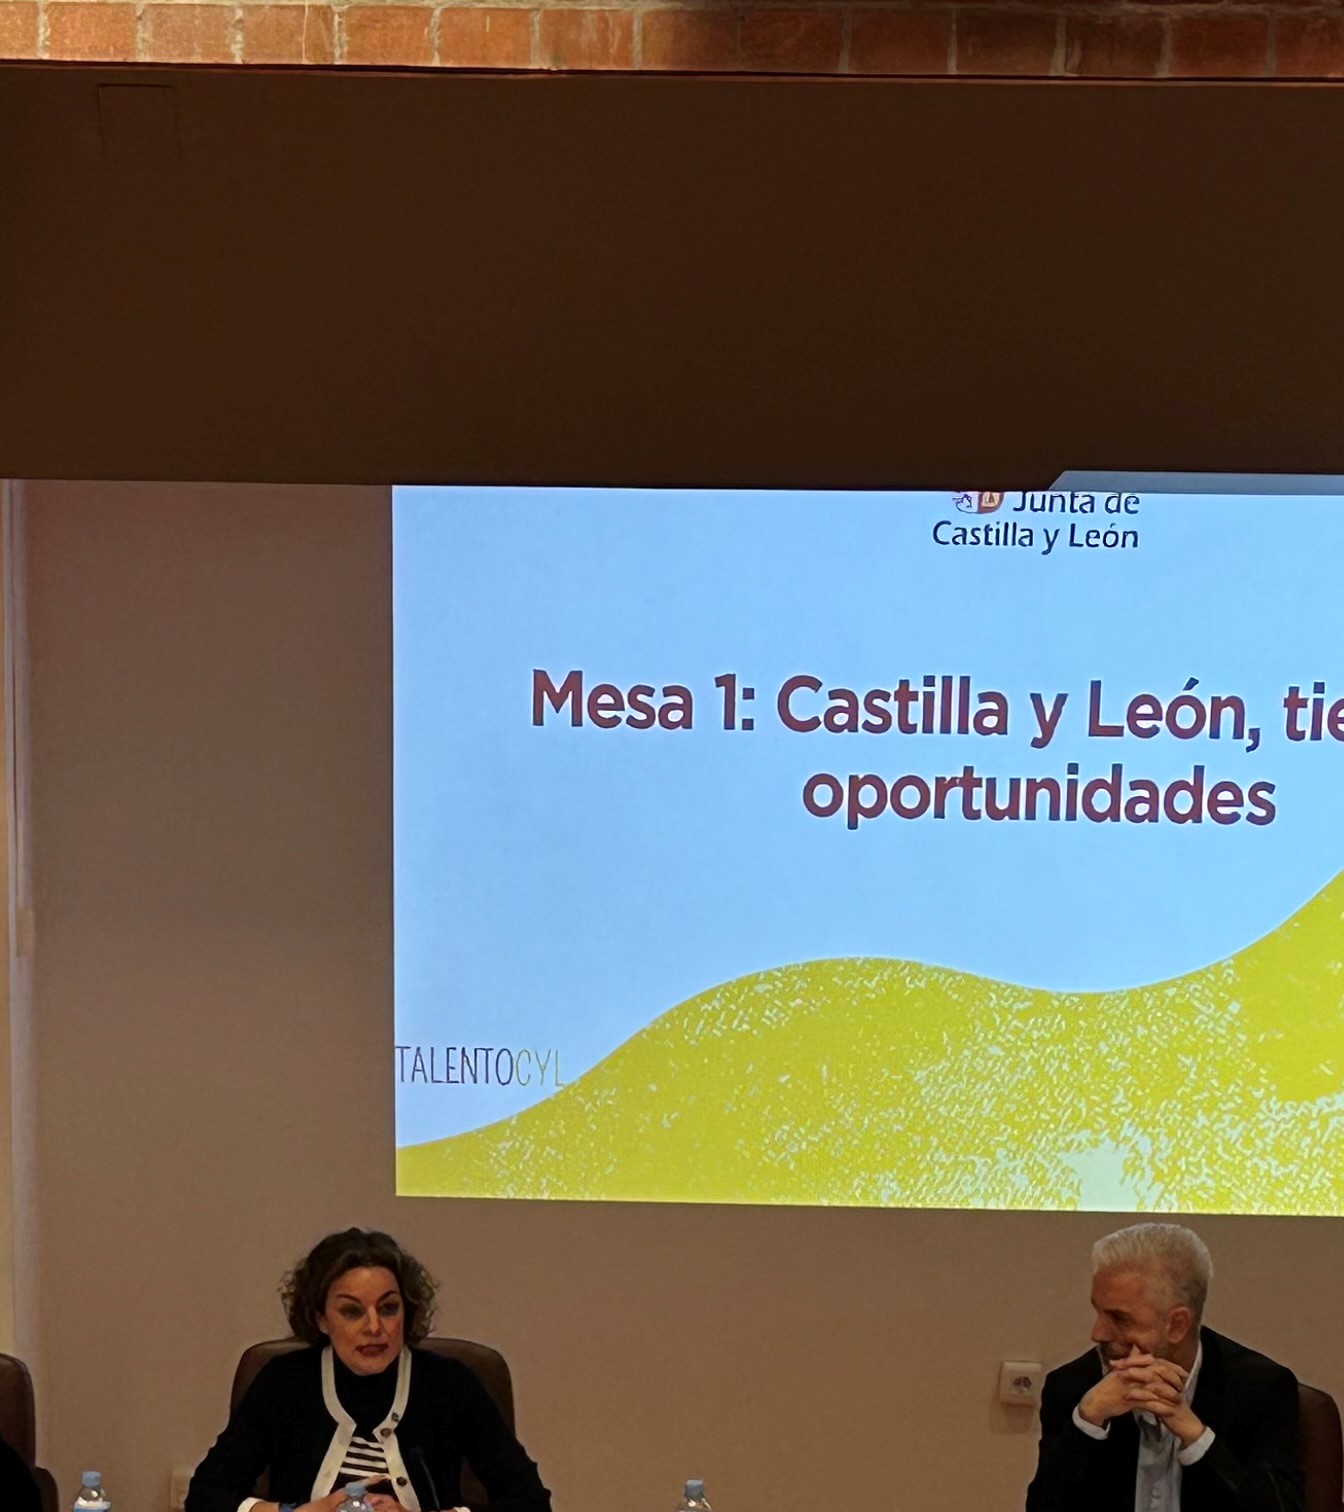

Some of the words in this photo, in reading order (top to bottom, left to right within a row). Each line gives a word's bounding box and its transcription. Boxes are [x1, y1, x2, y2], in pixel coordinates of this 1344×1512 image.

[1013, 491, 1095, 513] Junta
[1105, 492, 1140, 514] de
[933, 521, 1034, 547] Castilla
[1042, 529, 1060, 555] y
[1069, 523, 1139, 548] León
[533, 669, 693, 730] Mesa
[715, 674, 755, 731] 1:
[778, 675, 1009, 737] Castilla
[1030, 693, 1069, 749] y
[1088, 677, 1261, 754] León,
[803, 763, 1277, 831] oportunidades
